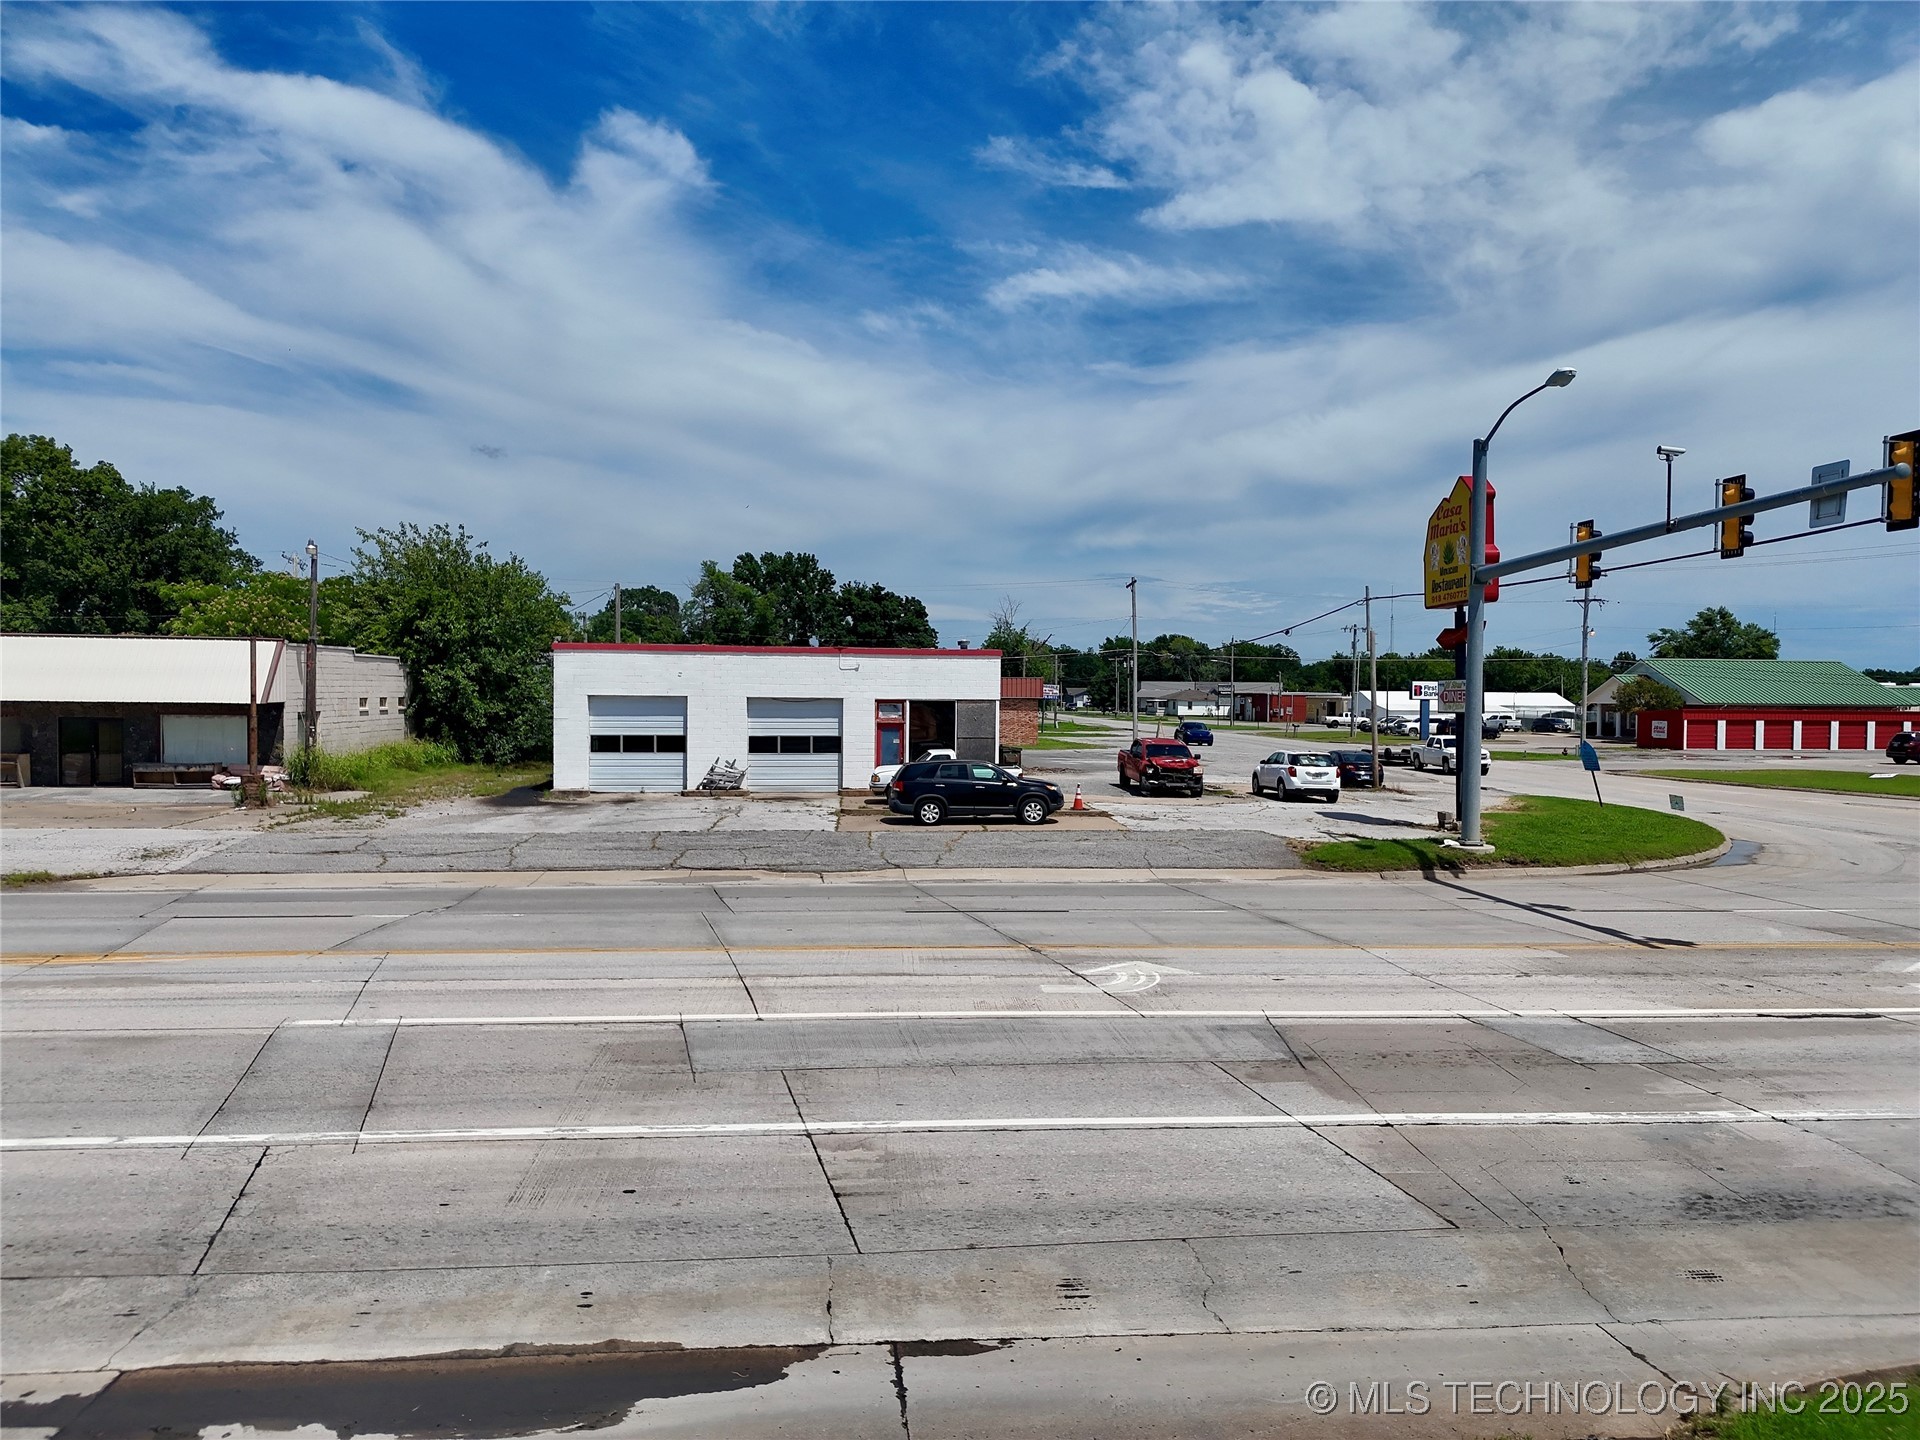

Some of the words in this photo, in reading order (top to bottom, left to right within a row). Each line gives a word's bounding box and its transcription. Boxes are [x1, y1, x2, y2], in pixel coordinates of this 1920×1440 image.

[1437, 505, 1462, 520] Casa
[1430, 518, 1466, 540] Maria's
[1431, 574, 1467, 593] Restaurant
